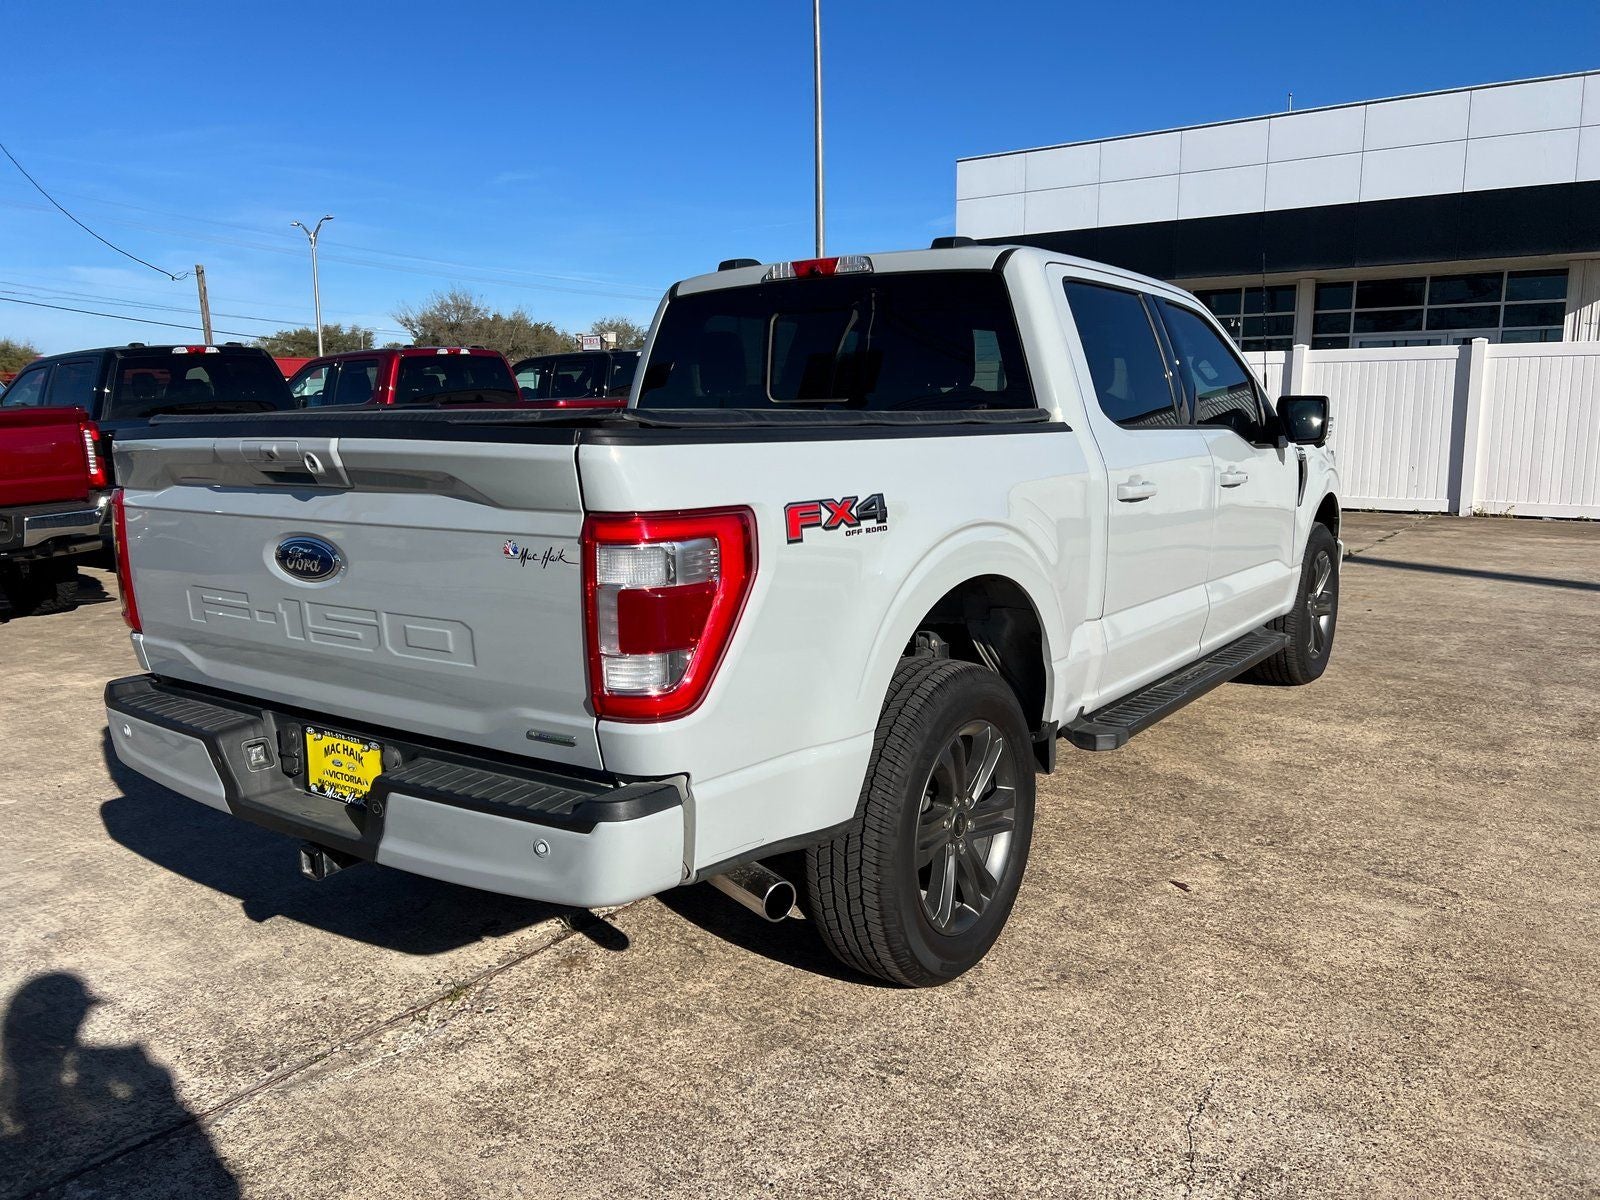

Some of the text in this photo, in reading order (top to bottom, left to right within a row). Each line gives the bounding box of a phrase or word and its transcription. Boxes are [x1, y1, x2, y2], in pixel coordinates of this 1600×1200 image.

[784, 493, 888, 545] FX4
[845, 525, 888, 537] OFF ROAD
[286, 546, 321, 573] Ford
[520, 546, 579, 569] Mac Haik
[186, 584, 477, 667] F-150
[324, 743, 341, 758] MAC
[342, 743, 365, 768] HAIK
[328, 769, 363, 786] VICTORIA
